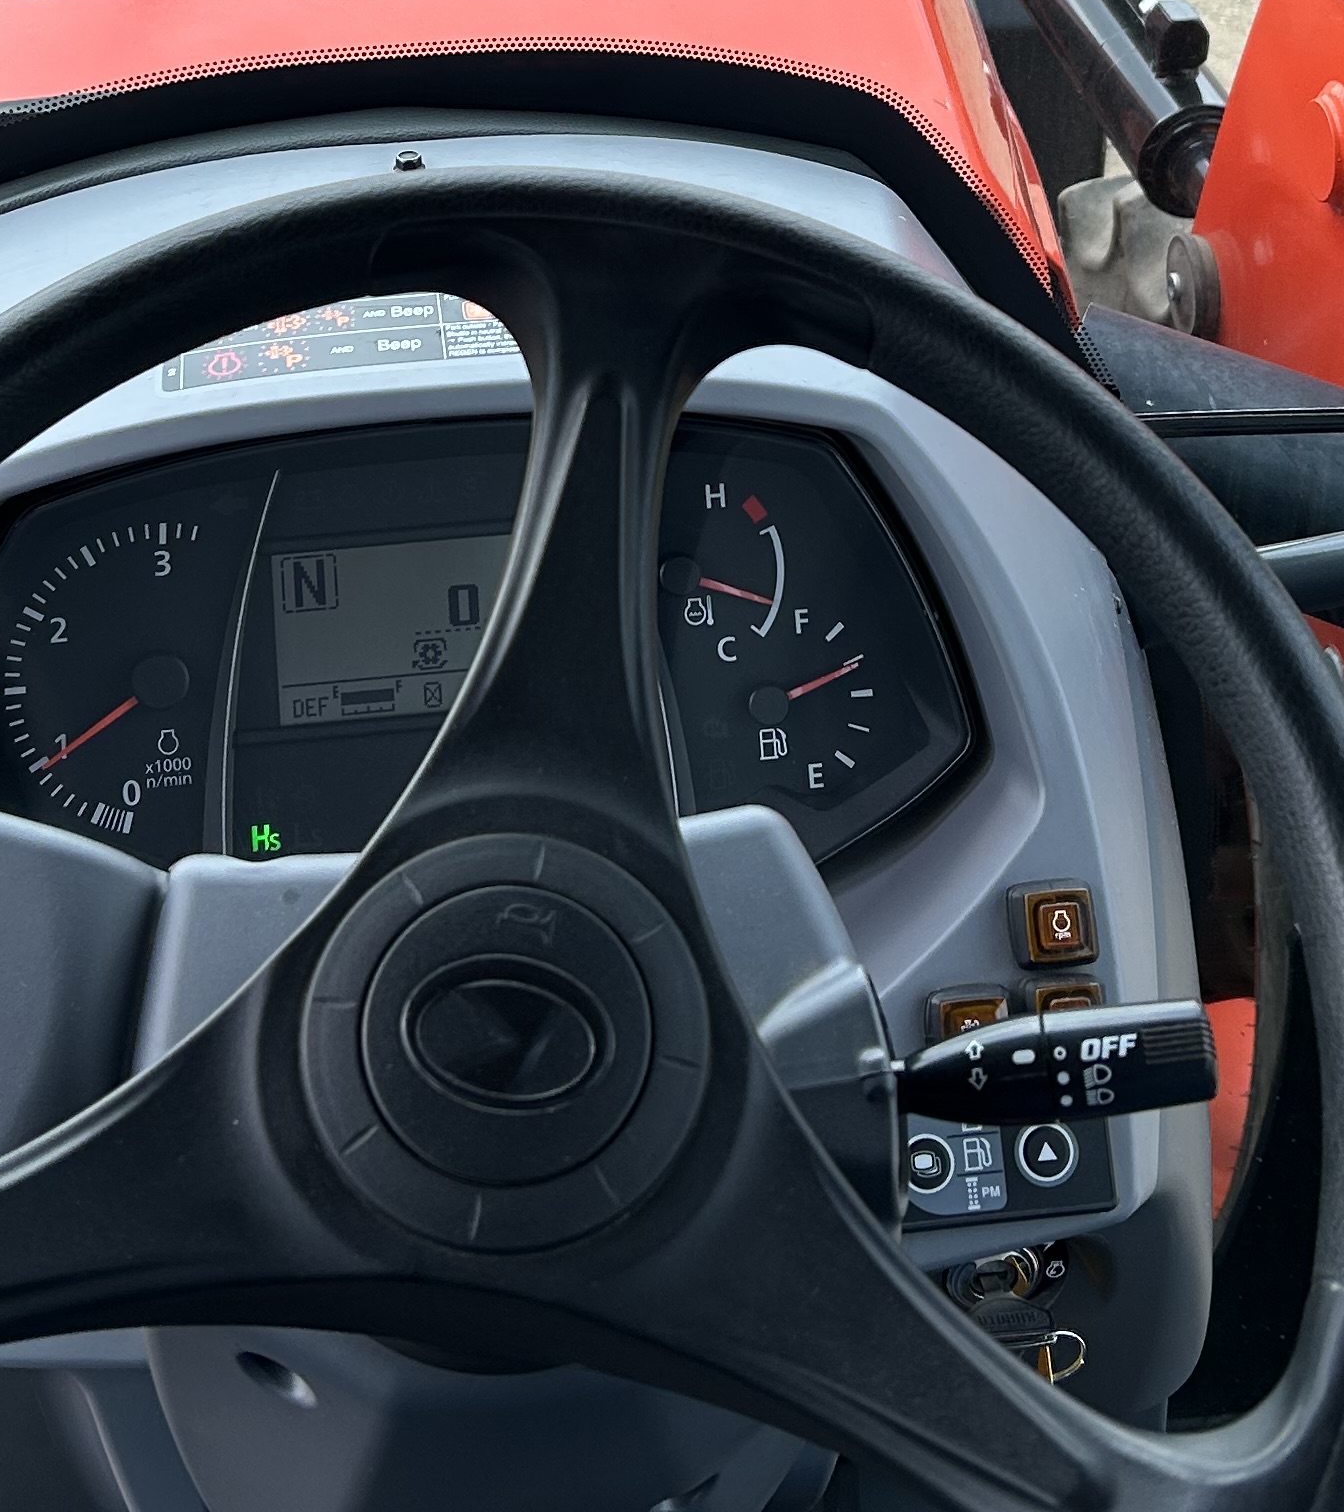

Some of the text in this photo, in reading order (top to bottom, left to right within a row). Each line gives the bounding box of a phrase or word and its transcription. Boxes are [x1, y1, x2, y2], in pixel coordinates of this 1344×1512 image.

[363, 305, 434, 318] AND Beep
[330, 345, 354, 355] AND
[377, 338, 422, 352] Beep
[705, 483, 726, 509] H
[154, 550, 171, 576] 3
[293, 558, 327, 608] N
[448, 584, 480, 626] 0
[50, 617, 68, 643] 2
[794, 609, 809, 634] F
[717, 636, 737, 662] C
[293, 696, 329, 718] DEF
[54, 733, 68, 759] 1
[145, 756, 192, 774] x1000
[807, 762, 825, 788] E
[122, 779, 141, 806] 0
[146, 774, 193, 788] n/min
[251, 823, 282, 853] Hs
[1080, 1033, 1137, 1061] OFF
[981, 1185, 1001, 1198] PM
